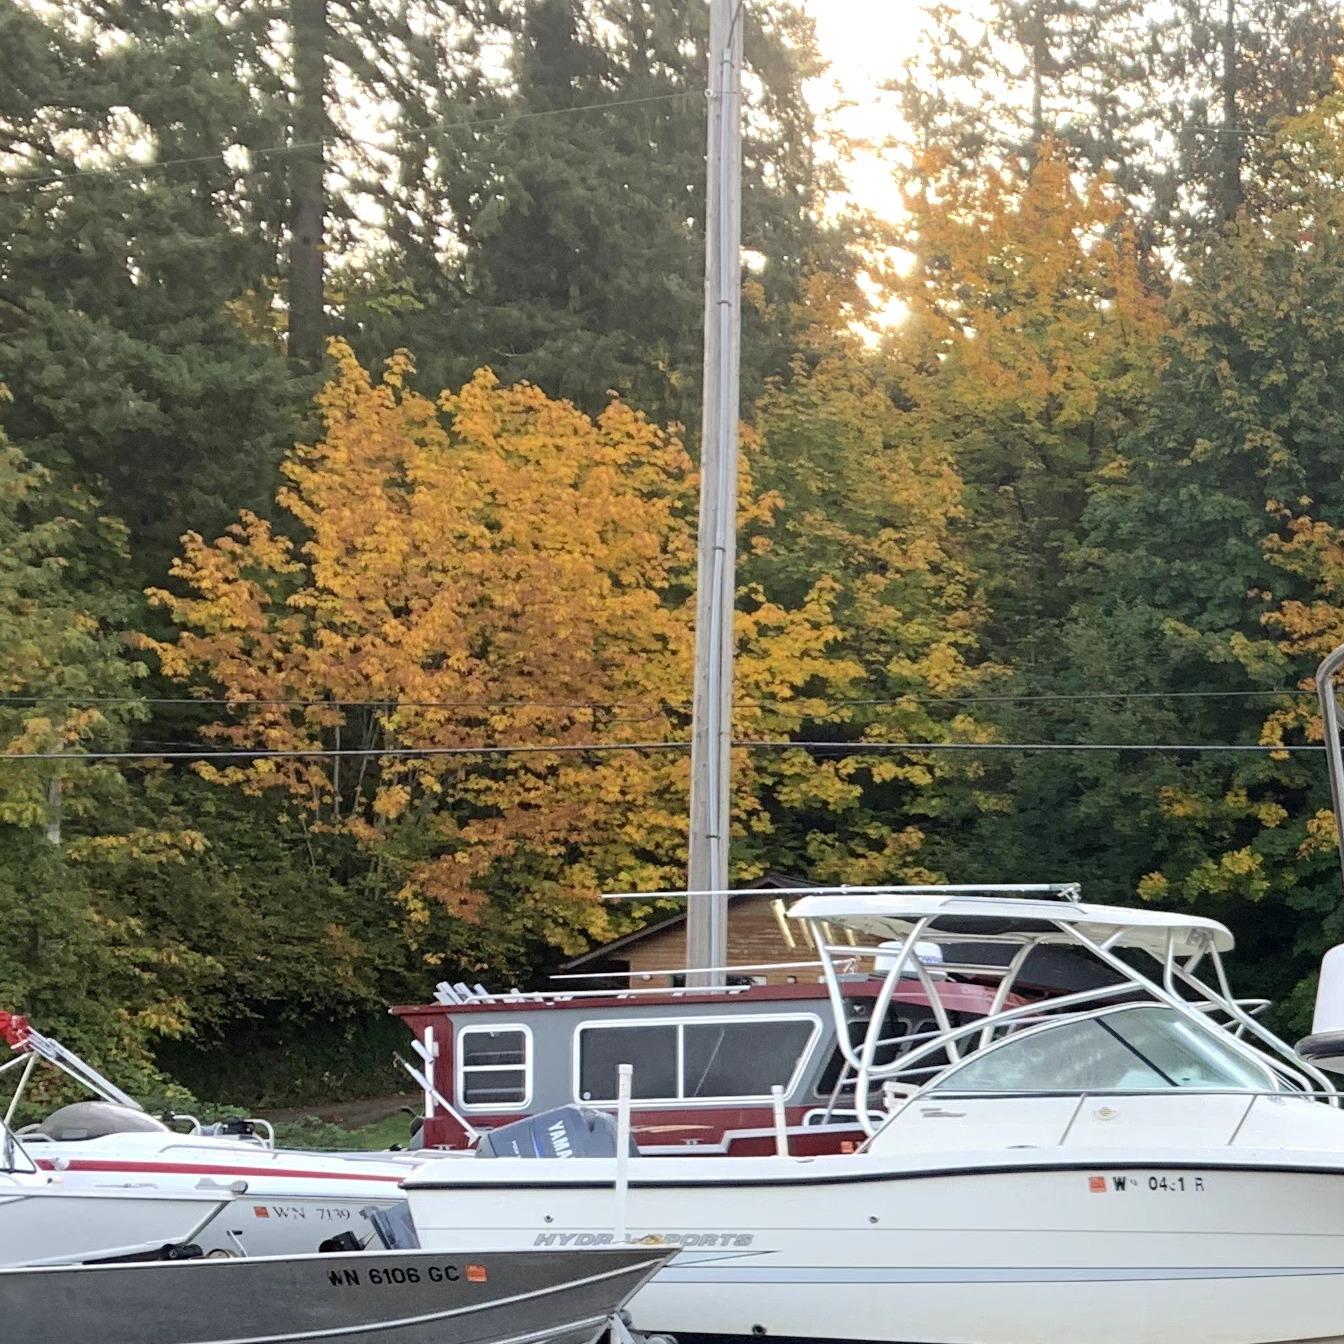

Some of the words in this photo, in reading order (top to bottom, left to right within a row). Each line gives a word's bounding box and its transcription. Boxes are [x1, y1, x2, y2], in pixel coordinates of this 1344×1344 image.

[272, 1206, 306, 1219] WN
[328, 1268, 361, 1287] WN
[368, 1267, 421, 1285] 6106
[428, 1265, 460, 1282] GC
